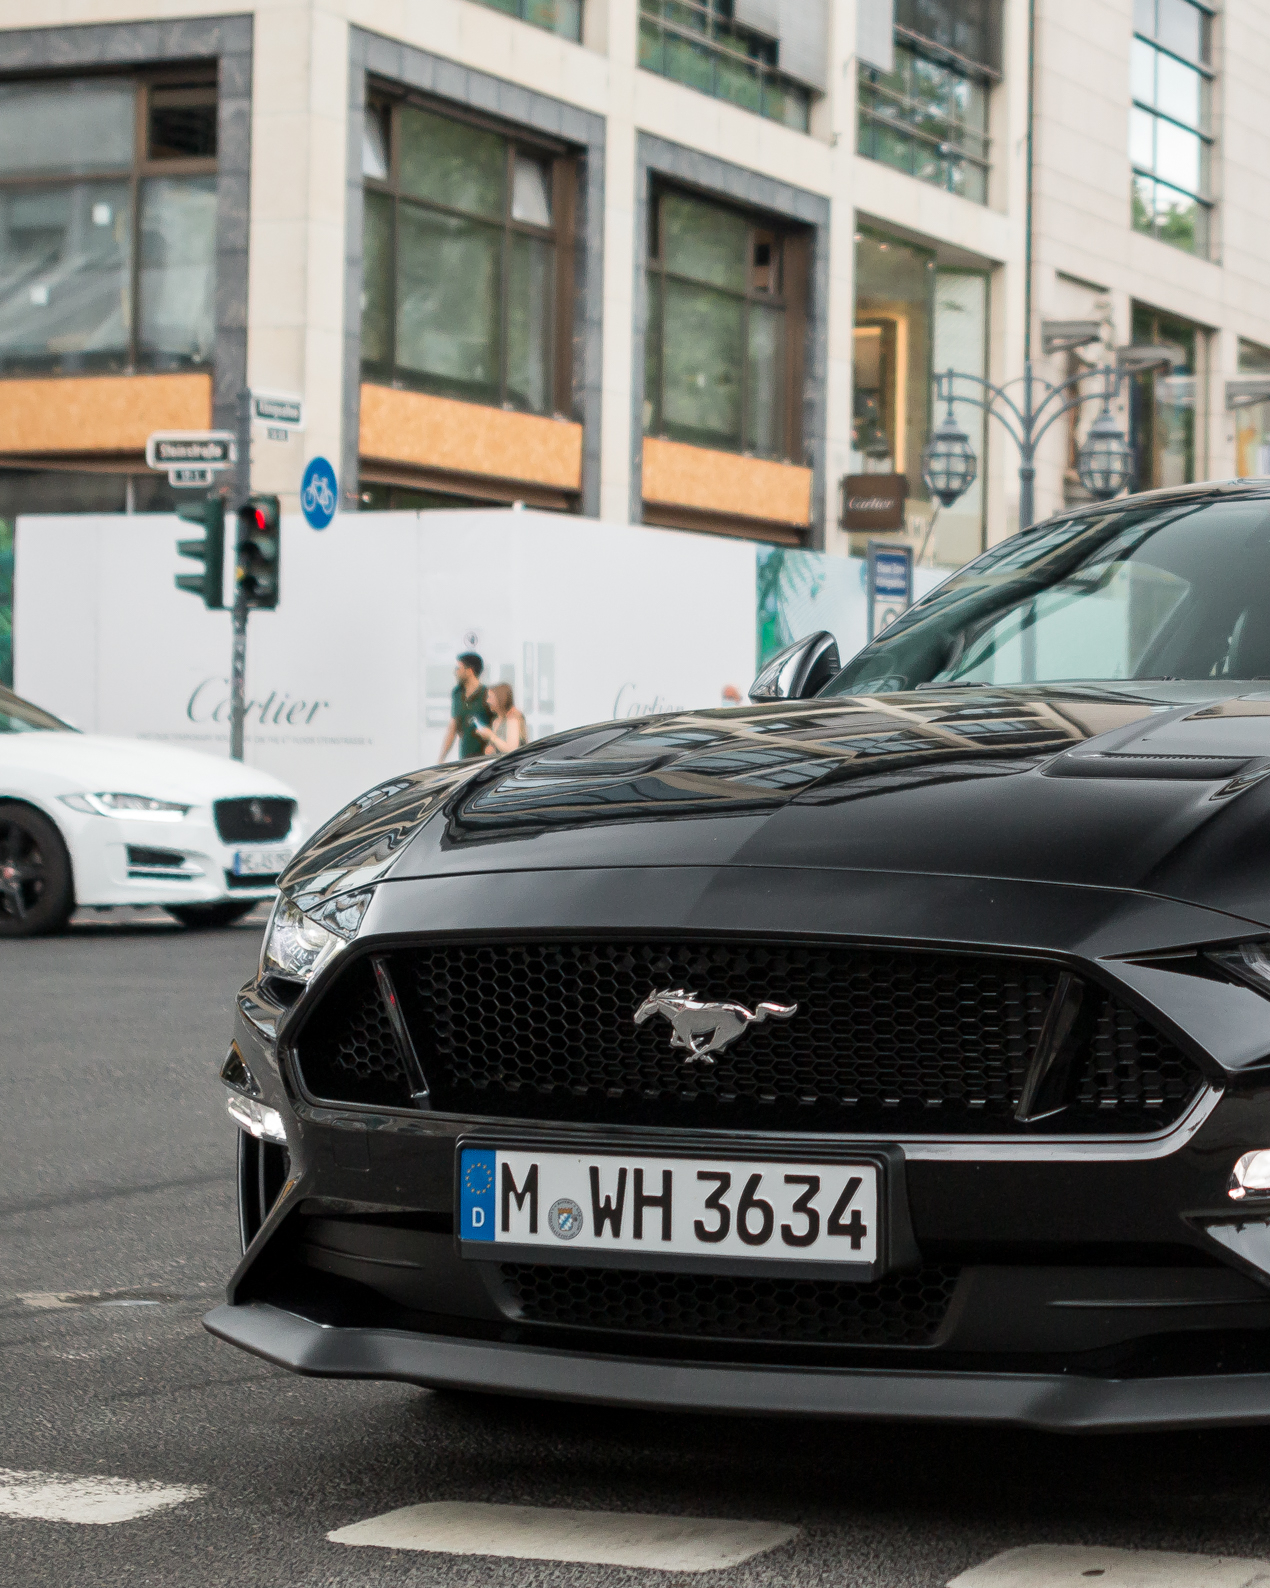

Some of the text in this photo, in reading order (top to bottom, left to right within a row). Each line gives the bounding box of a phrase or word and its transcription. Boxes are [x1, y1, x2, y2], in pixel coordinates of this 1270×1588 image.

[848, 496, 894, 510] Cartier
[186, 676, 330, 725] Cartier
[471, 1207, 484, 1228] D
[500, 1162, 539, 1234] M
[588, 1165, 673, 1242] WH
[693, 1170, 868, 1251] 3634
